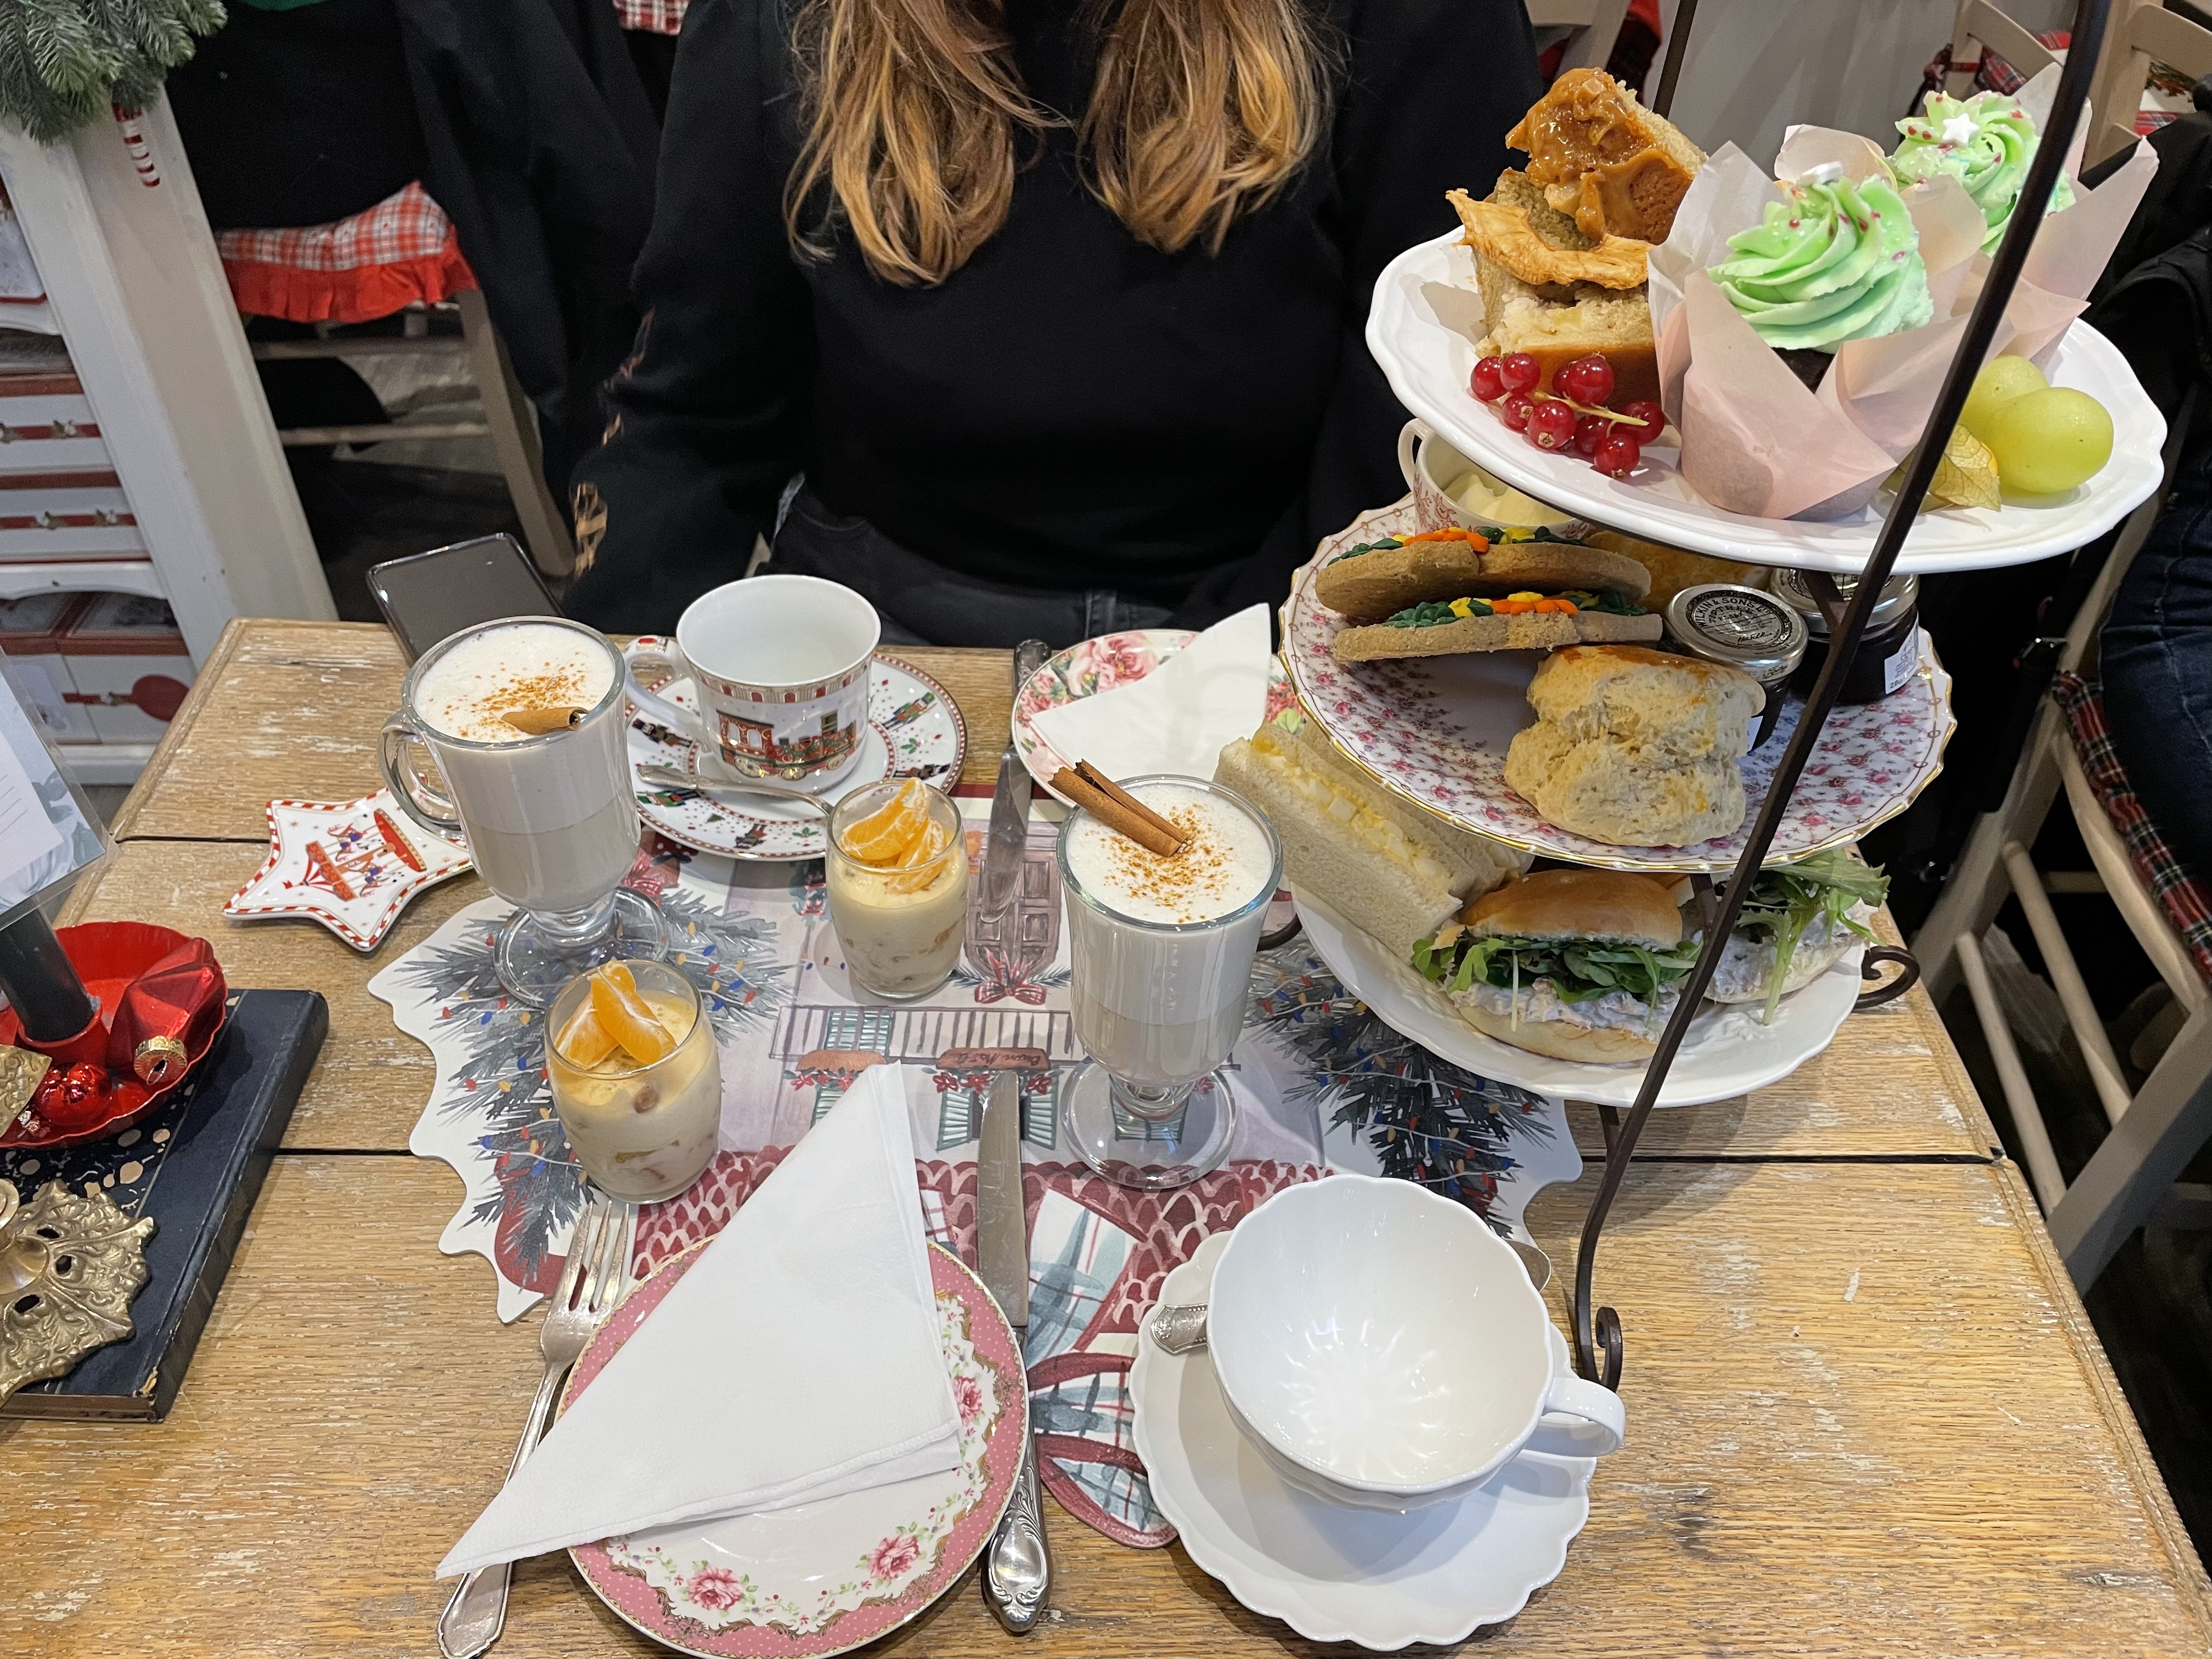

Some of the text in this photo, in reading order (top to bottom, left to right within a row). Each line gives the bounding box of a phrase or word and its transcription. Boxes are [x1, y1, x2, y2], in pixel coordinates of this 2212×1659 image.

[1694, 601, 1713, 628] WILKIN
[1722, 597, 1756, 608] SONS
[1708, 605, 1754, 623] TIPTREE
